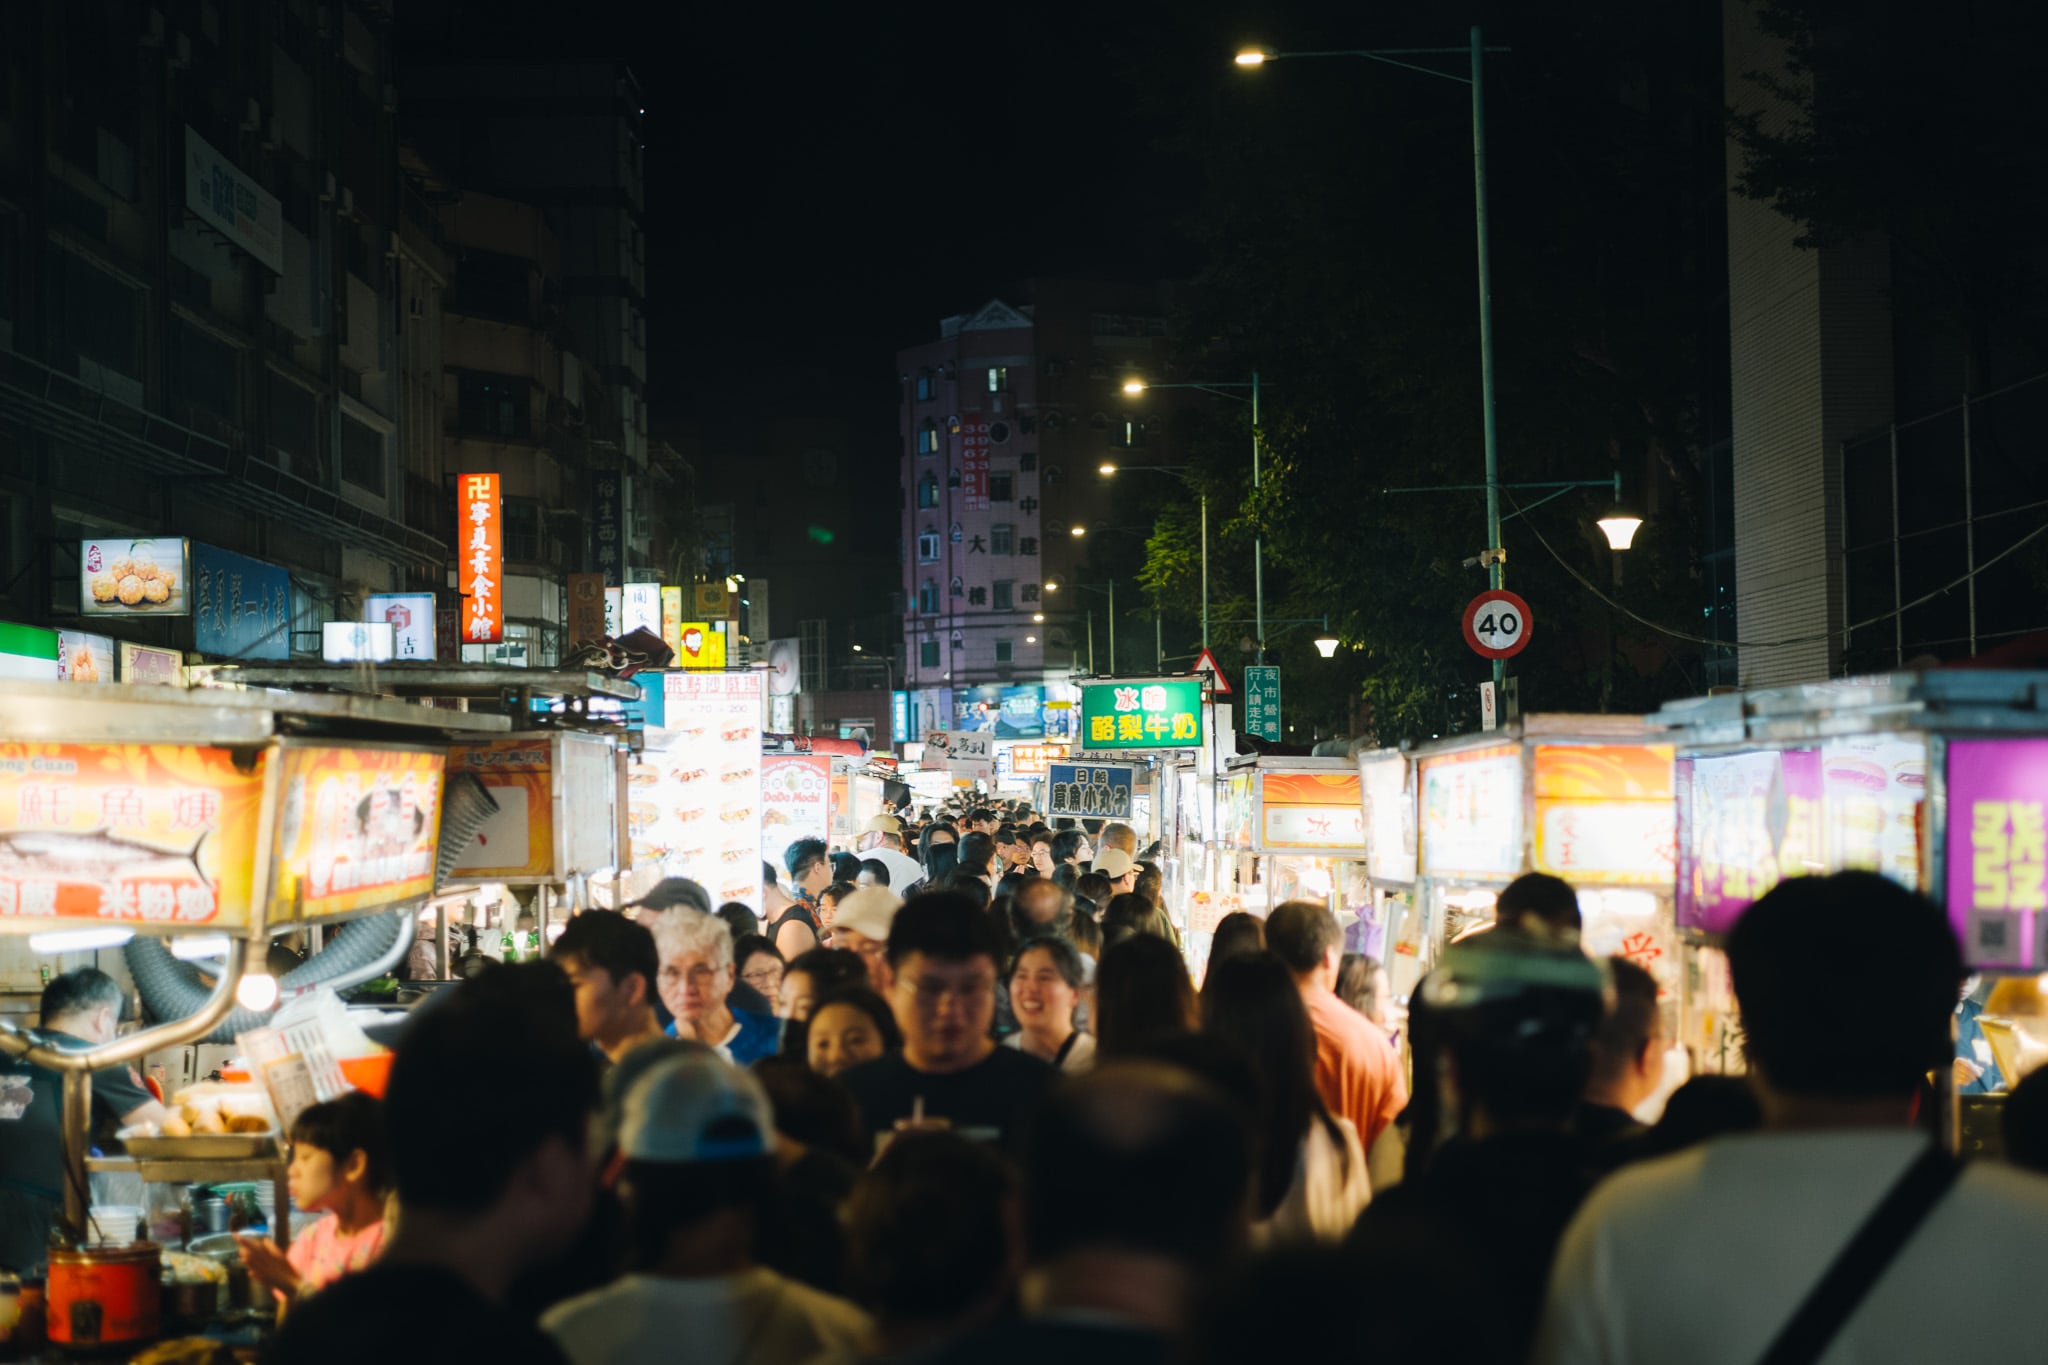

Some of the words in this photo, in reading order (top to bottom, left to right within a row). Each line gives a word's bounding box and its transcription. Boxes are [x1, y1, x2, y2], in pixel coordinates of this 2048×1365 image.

[469, 501, 495, 640] 寧夏素食小館
[1479, 613, 1518, 636] 40
[1249, 669, 1262, 737] 行人請走右
[1264, 669, 1277, 733] 夜市營業
[1091, 713, 1197, 742] 酪梨牛奶
[31, 758, 76, 773] Guan
[1054, 783, 1128, 815] 章魚小丸子
[98, 882, 216, 921] 米粉炒
